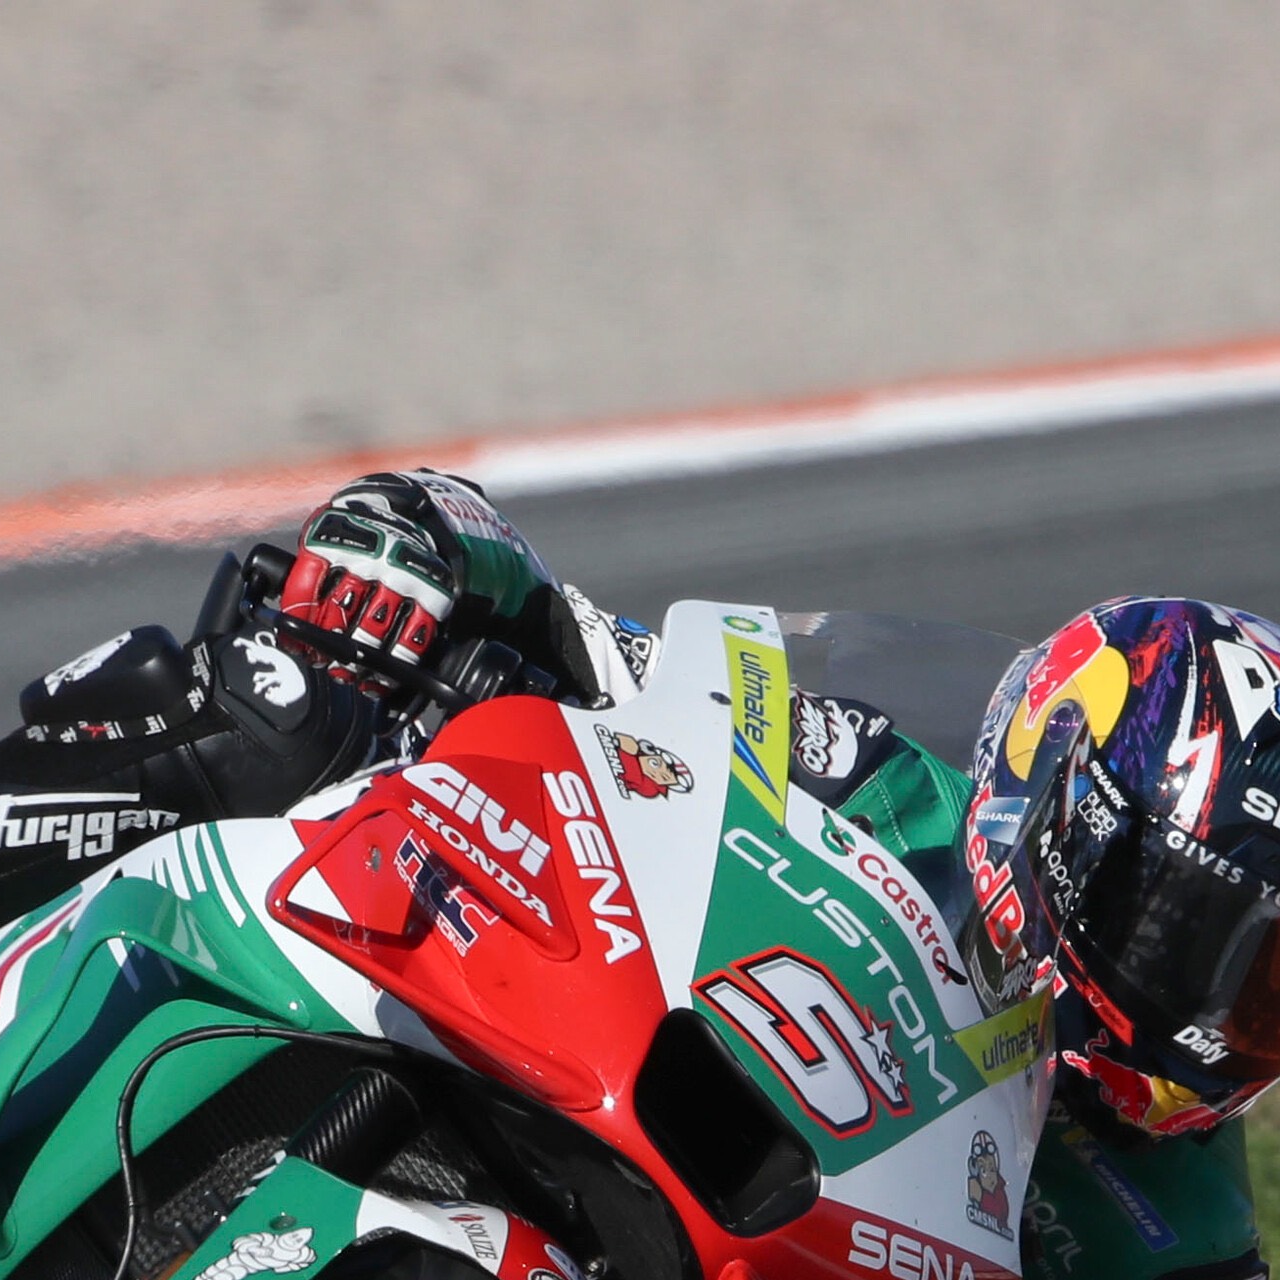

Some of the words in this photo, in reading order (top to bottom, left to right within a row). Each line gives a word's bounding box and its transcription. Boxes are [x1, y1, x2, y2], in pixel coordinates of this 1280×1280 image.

[739, 651, 773, 744] ultimate
[402, 762, 552, 877] GIVI
[975, 810, 1022, 824] SHARK
[1089, 760, 1129, 810] SHARK
[407, 798, 554, 927] HONDA
[542, 770, 643, 965] SENA
[1166, 830, 1245, 885] GIVES
[723, 827, 959, 1105] CUSTOM
[693, 946, 913, 1139] 5
[982, 1019, 1040, 1072] ultimate
[1172, 1024, 1231, 1065] Dafy
[1095, 1163, 1162, 1238] MICHELIN
